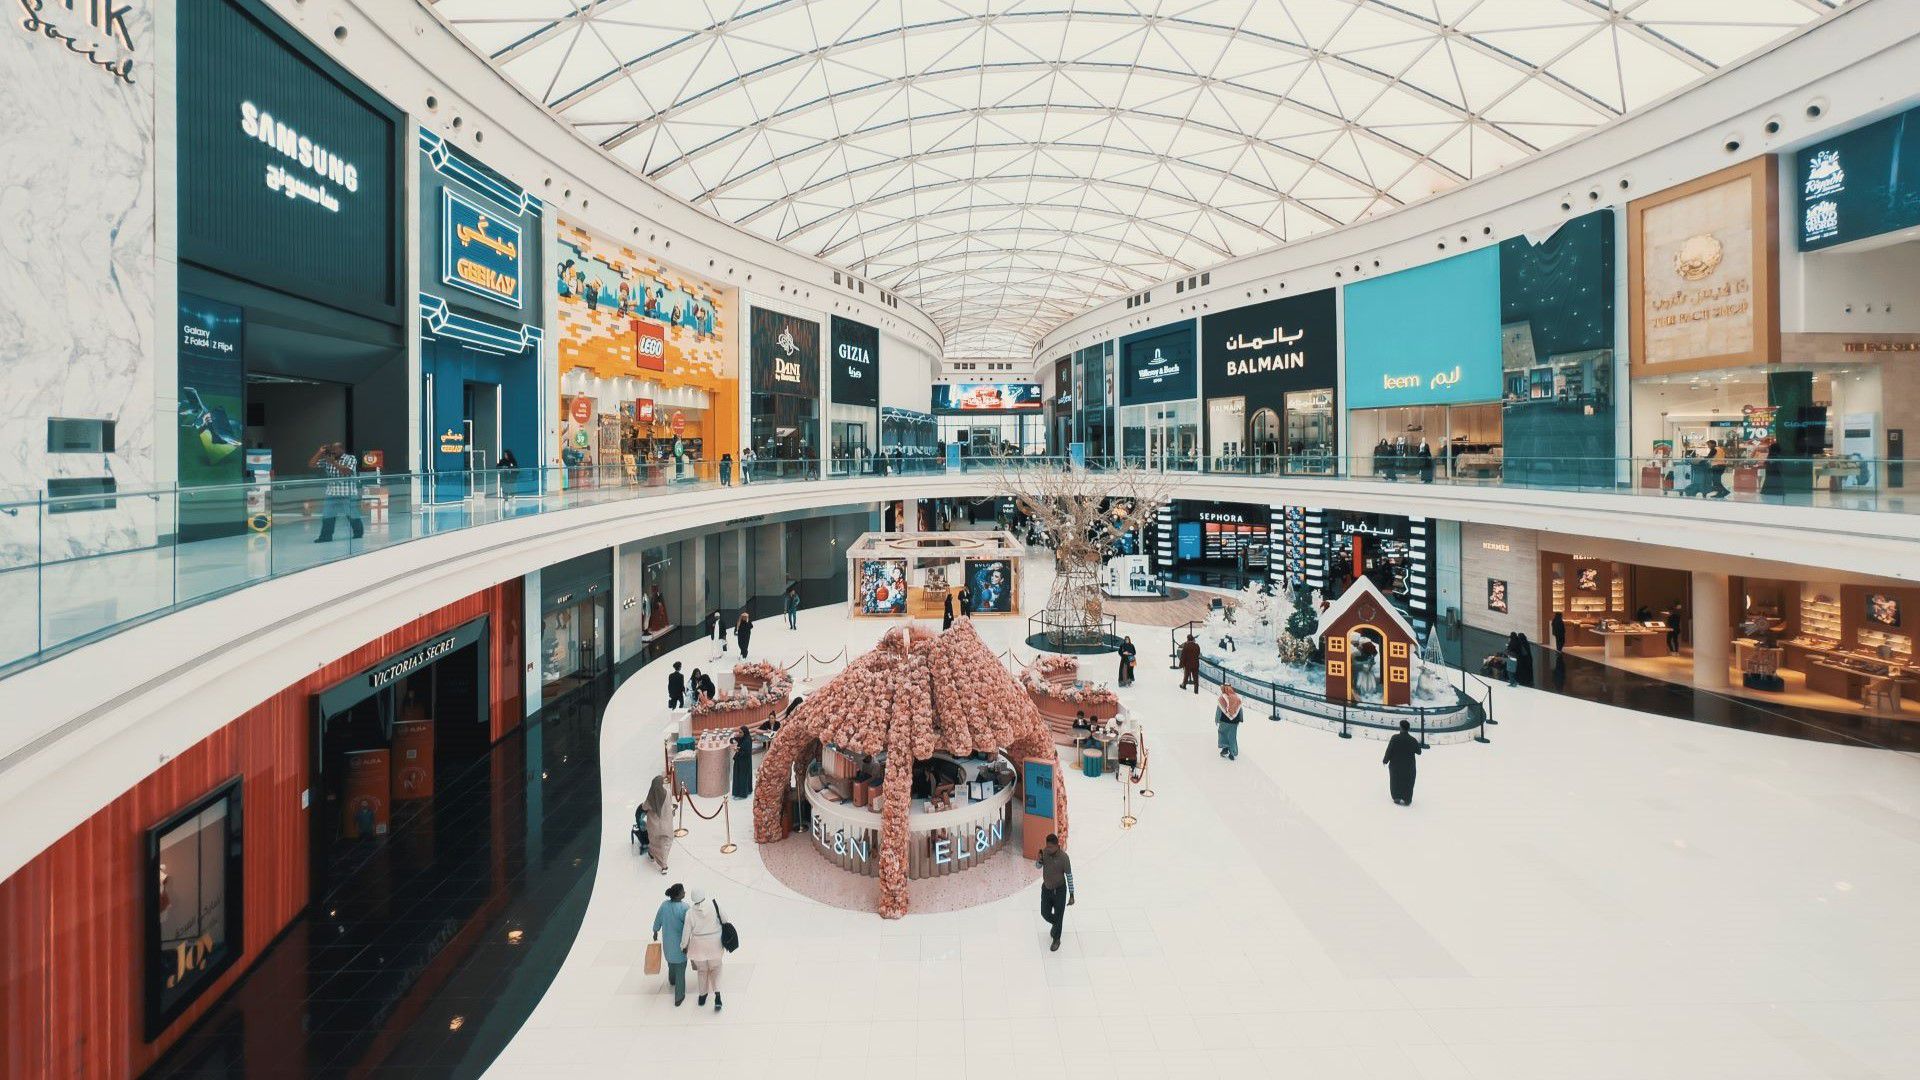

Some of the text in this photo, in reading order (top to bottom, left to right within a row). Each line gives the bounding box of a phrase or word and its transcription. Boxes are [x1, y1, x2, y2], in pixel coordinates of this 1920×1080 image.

[241, 100, 358, 193] SAMSUNG
[266, 164, 339, 212] سامسونج
[457, 258, 516, 296] GEEKAY
[183, 324, 210, 339] Galaxy
[1226, 326, 1304, 351] بالمان
[184, 335, 234, 353] Z Fold4 Z Flip4
[639, 334, 663, 358] LEGO
[838, 343, 870, 364] GIZIA
[775, 357, 801, 376] DANI
[1227, 351, 1304, 376] BALMAIN
[1383, 373, 1420, 390] leem
[1430, 365, 1460, 390] ليم
[1746, 427, 1768, 439] 70
[1199, 512, 1244, 523] SEPHORA
[1341, 520, 1394, 536] سيفورا
[374, 637, 457, 688] VICTORIA'S SECRET
[812, 815, 867, 863] EL&N
[935, 819, 1003, 864] EL&N
